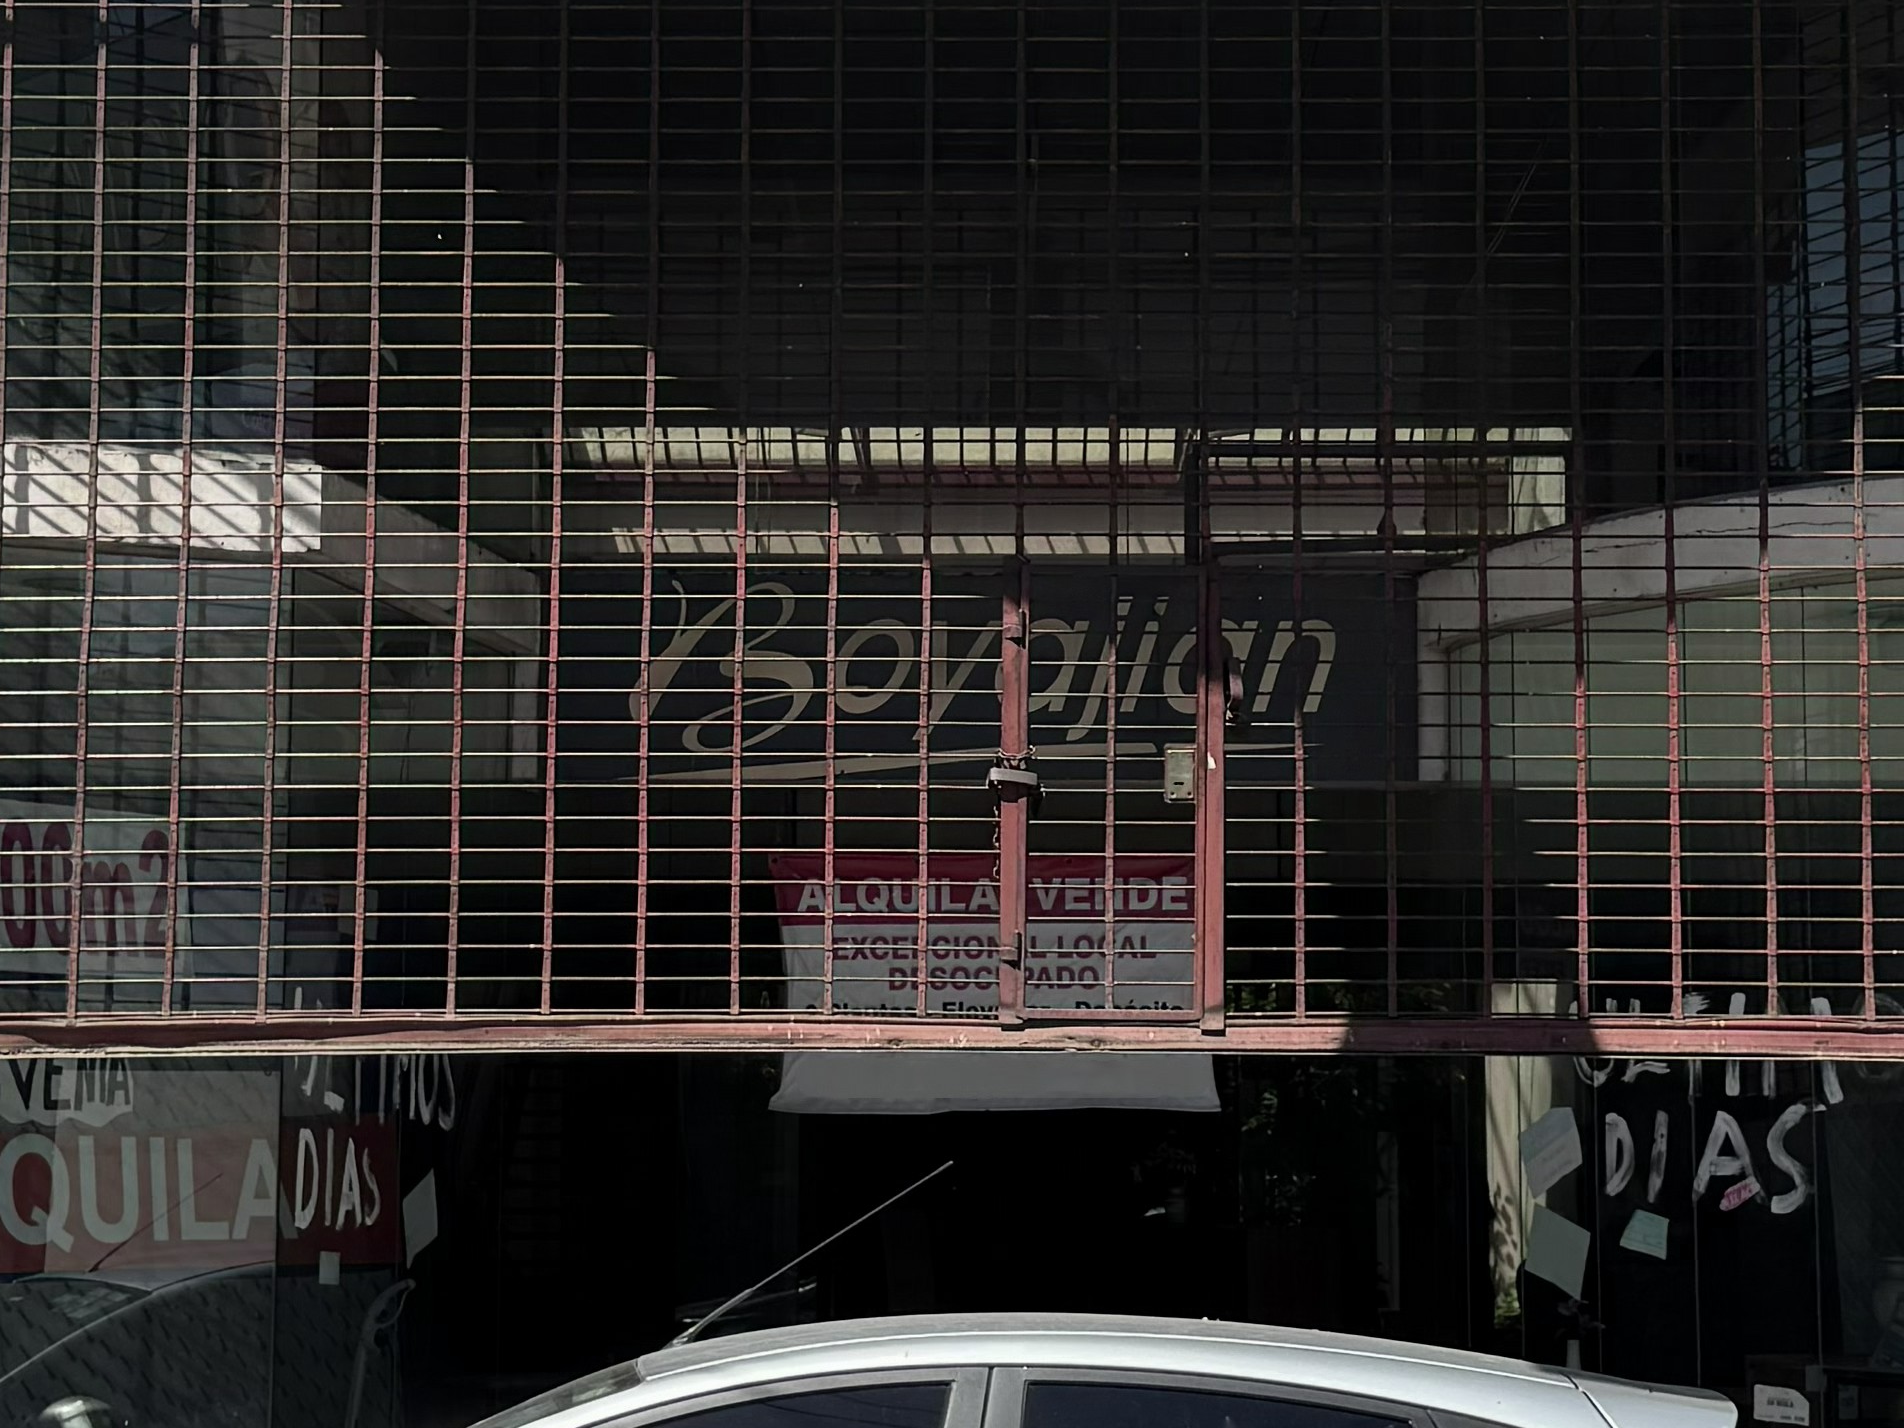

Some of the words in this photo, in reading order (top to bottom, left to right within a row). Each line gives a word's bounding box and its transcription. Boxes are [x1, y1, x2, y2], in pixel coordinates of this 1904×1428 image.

[629, 580, 1337, 752] Boyajian
[796, 876, 1002, 913] ALQUILA
[1032, 876, 1188, 911] VENDE
[294, 1127, 382, 1230] DIAS
[1604, 1103, 1827, 1214] DIAS
